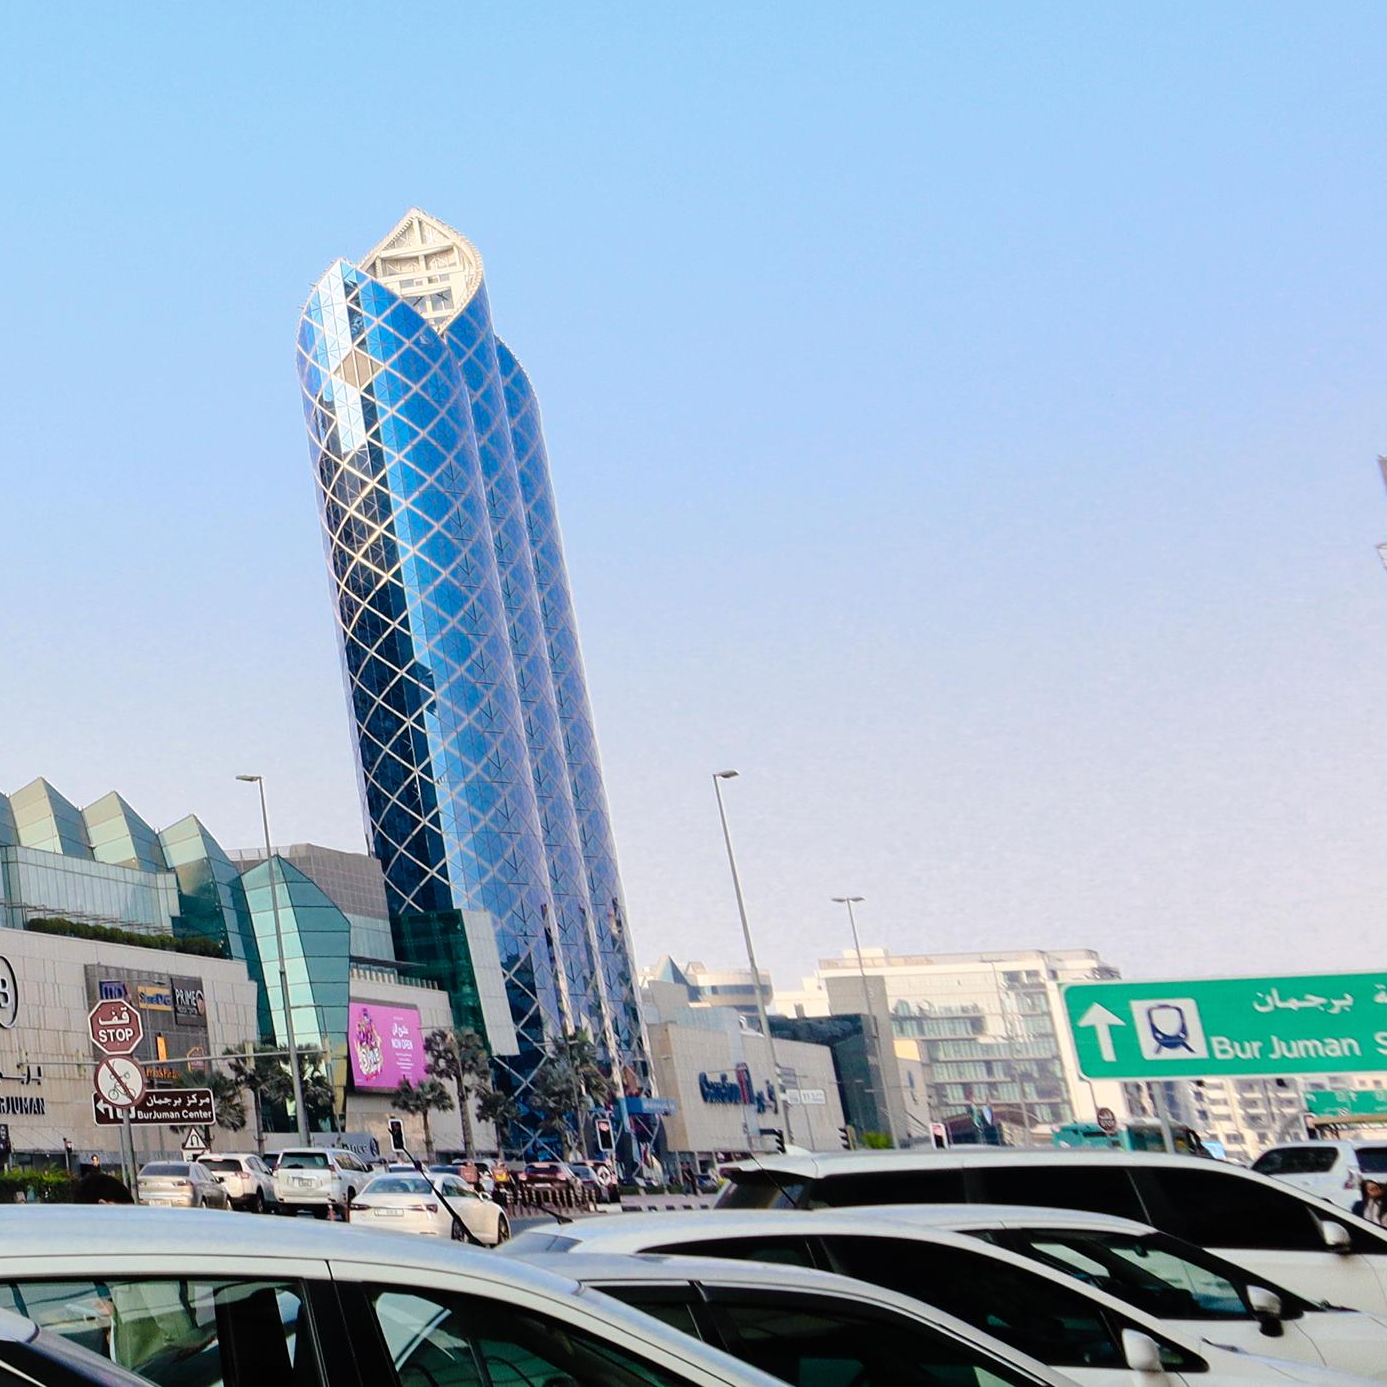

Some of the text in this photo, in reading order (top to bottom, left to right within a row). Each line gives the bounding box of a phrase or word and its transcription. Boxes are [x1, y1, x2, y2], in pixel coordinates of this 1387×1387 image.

[175, 987, 197, 1006] PRIME
[1252, 987, 1355, 1014] برجمان
[98, 1006, 130, 1026] قف
[98, 1028, 134, 1043] STOP
[1210, 1035, 1264, 1060] Bur
[1268, 1034, 1363, 1059] Juman
[146, 1093, 211, 1107] مركز برجمان
[137, 1109, 212, 1120] BurJuman Center
